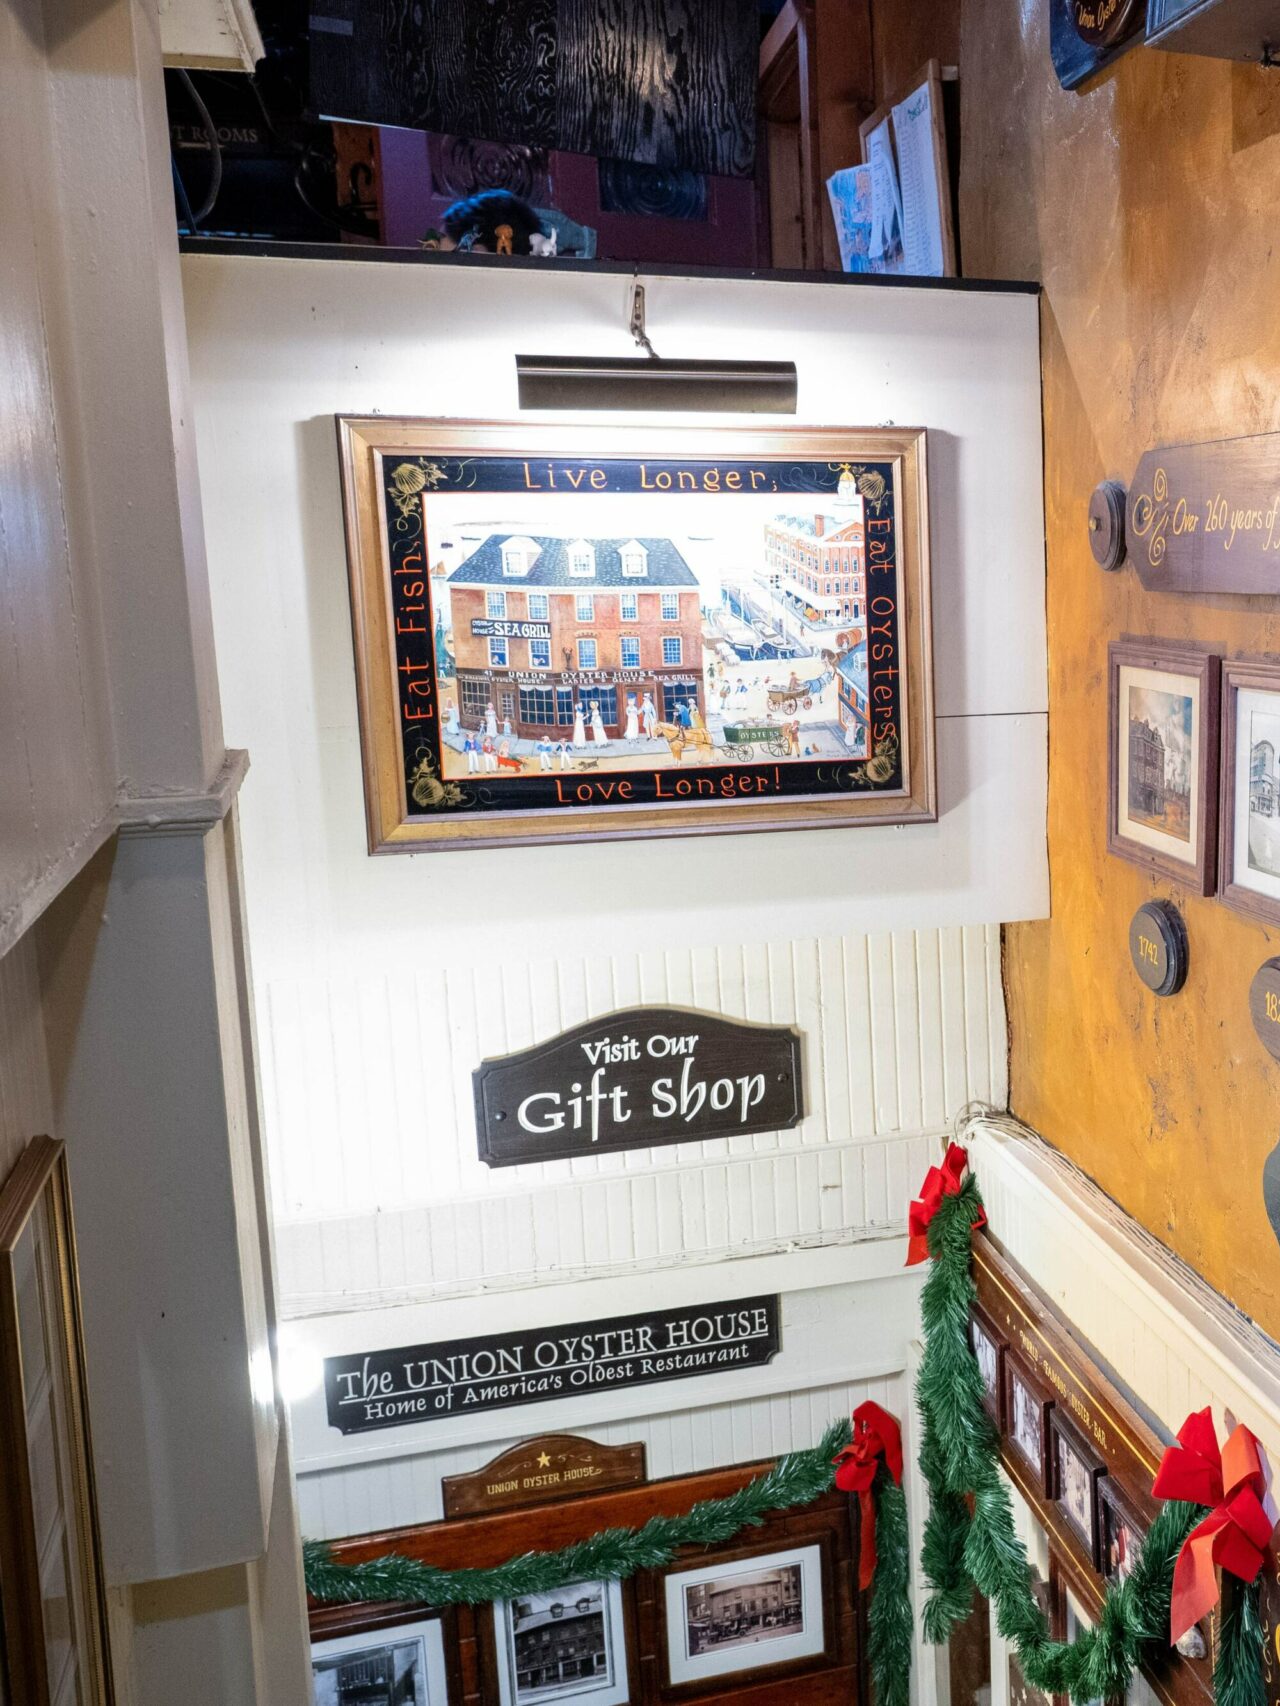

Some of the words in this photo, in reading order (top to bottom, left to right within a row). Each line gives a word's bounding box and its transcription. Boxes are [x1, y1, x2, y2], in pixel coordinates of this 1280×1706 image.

[523, 462, 608, 489] Live
[1173, 498, 1199, 535] Over
[1205, 494, 1228, 532] 260
[1225, 505, 1263, 550] years
[1263, 495, 1280, 551] of
[868, 519, 893, 576] Eat
[494, 622, 521, 636] SEA
[522, 624, 550, 638] GRILL
[399, 656, 433, 720] Eat
[508, 671, 547, 680] UNION
[561, 671, 608, 679] OYSTER
[614, 670, 655, 678] HOUSE
[555, 780, 634, 803] Love
[655, 767, 779, 797] Longer!
[1138, 935, 1159, 965] 1742
[581, 1035, 641, 1065] Visit
[647, 1034, 699, 1058] Our
[517, 1067, 632, 1141] Gift
[651, 1057, 766, 1123] Shop
[337, 1357, 394, 1402] The
[404, 1345, 524, 1389] UNION
[534, 1326, 657, 1367] OYSTER
[665, 1308, 769, 1350] HOUSE
[364, 1390, 427, 1420] Home
[434, 1383, 453, 1411] of
[462, 1374, 563, 1404] America's
[570, 1359, 634, 1385] Oldest
[640, 1343, 750, 1374] Restaurant
[1093, 1420, 1108, 1450] BAR
[487, 1480, 519, 1495] UNION
[523, 1473, 560, 1489] OYSTER
[564, 1466, 596, 1481] HOUSE
